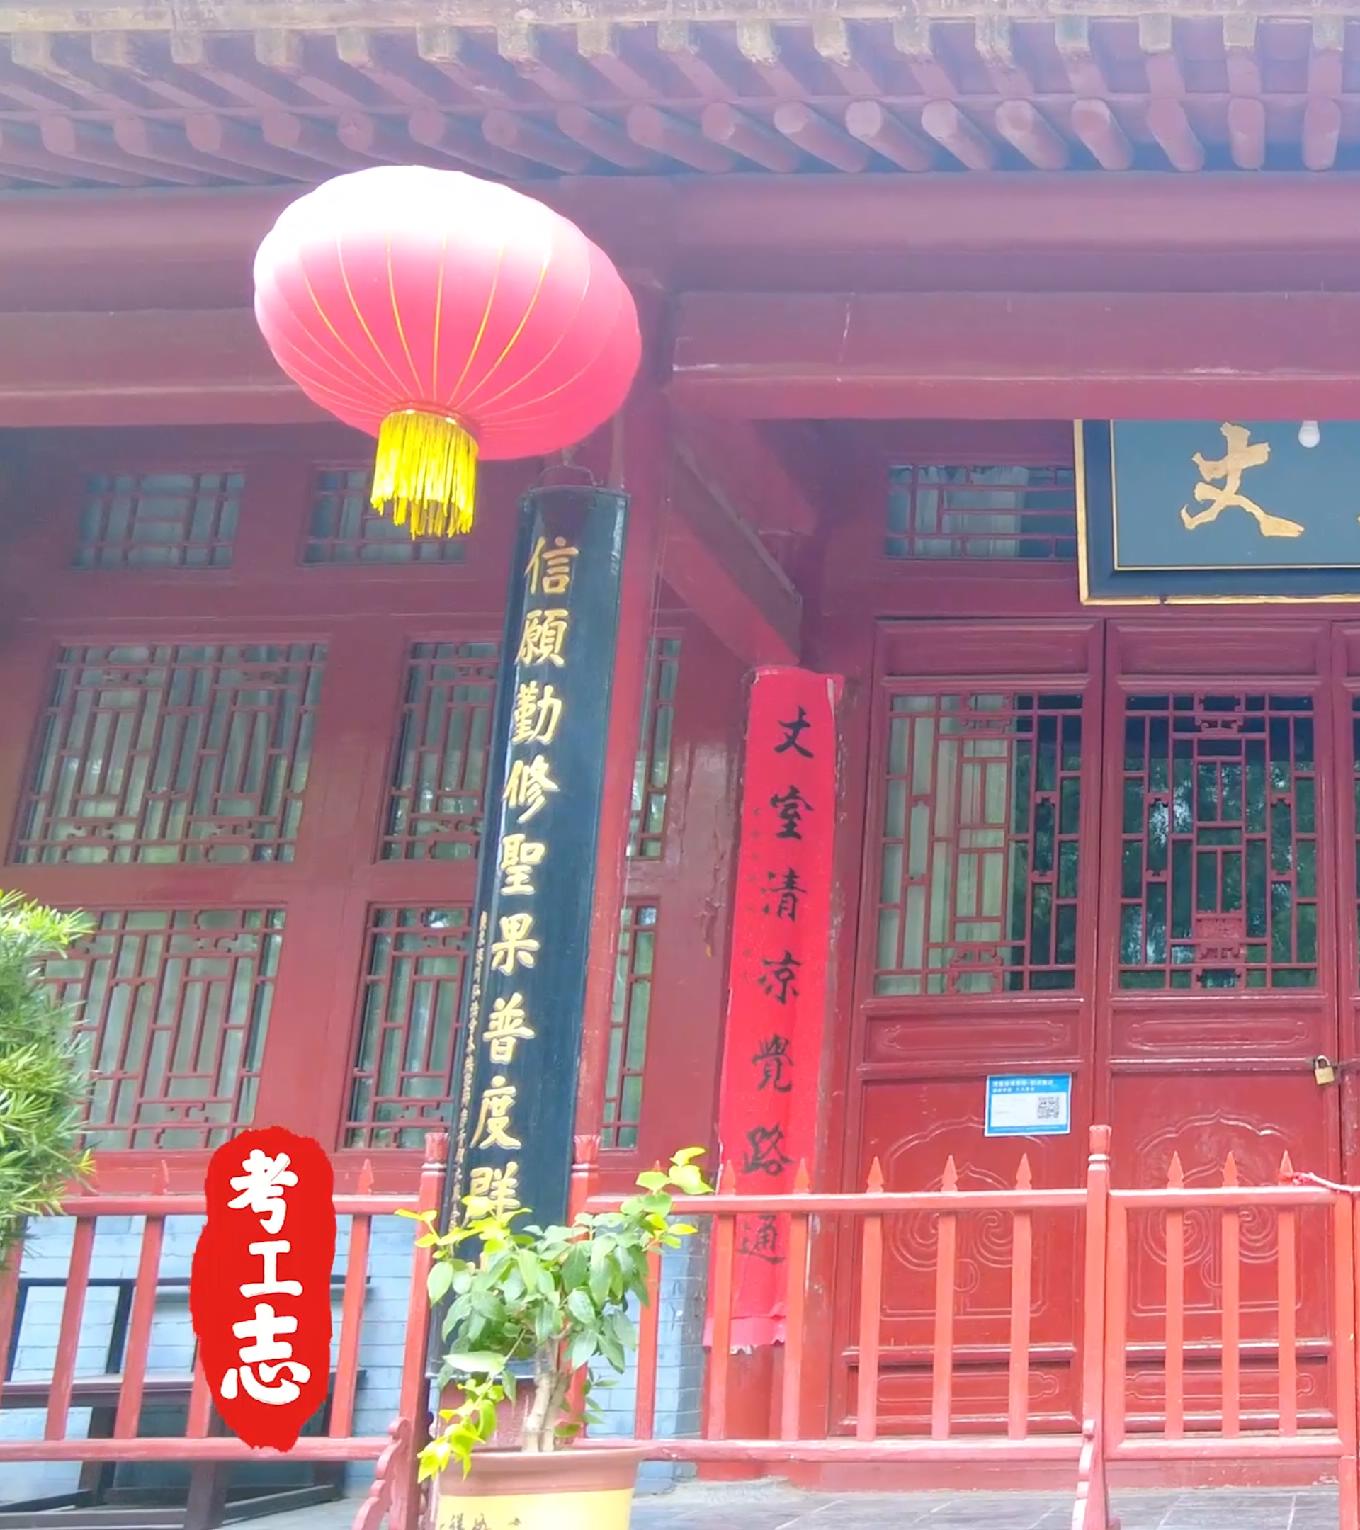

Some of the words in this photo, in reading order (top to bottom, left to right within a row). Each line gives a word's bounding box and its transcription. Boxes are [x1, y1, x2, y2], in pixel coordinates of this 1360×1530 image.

[463, 535, 580, 1272] 信願勤修聖果普度群
